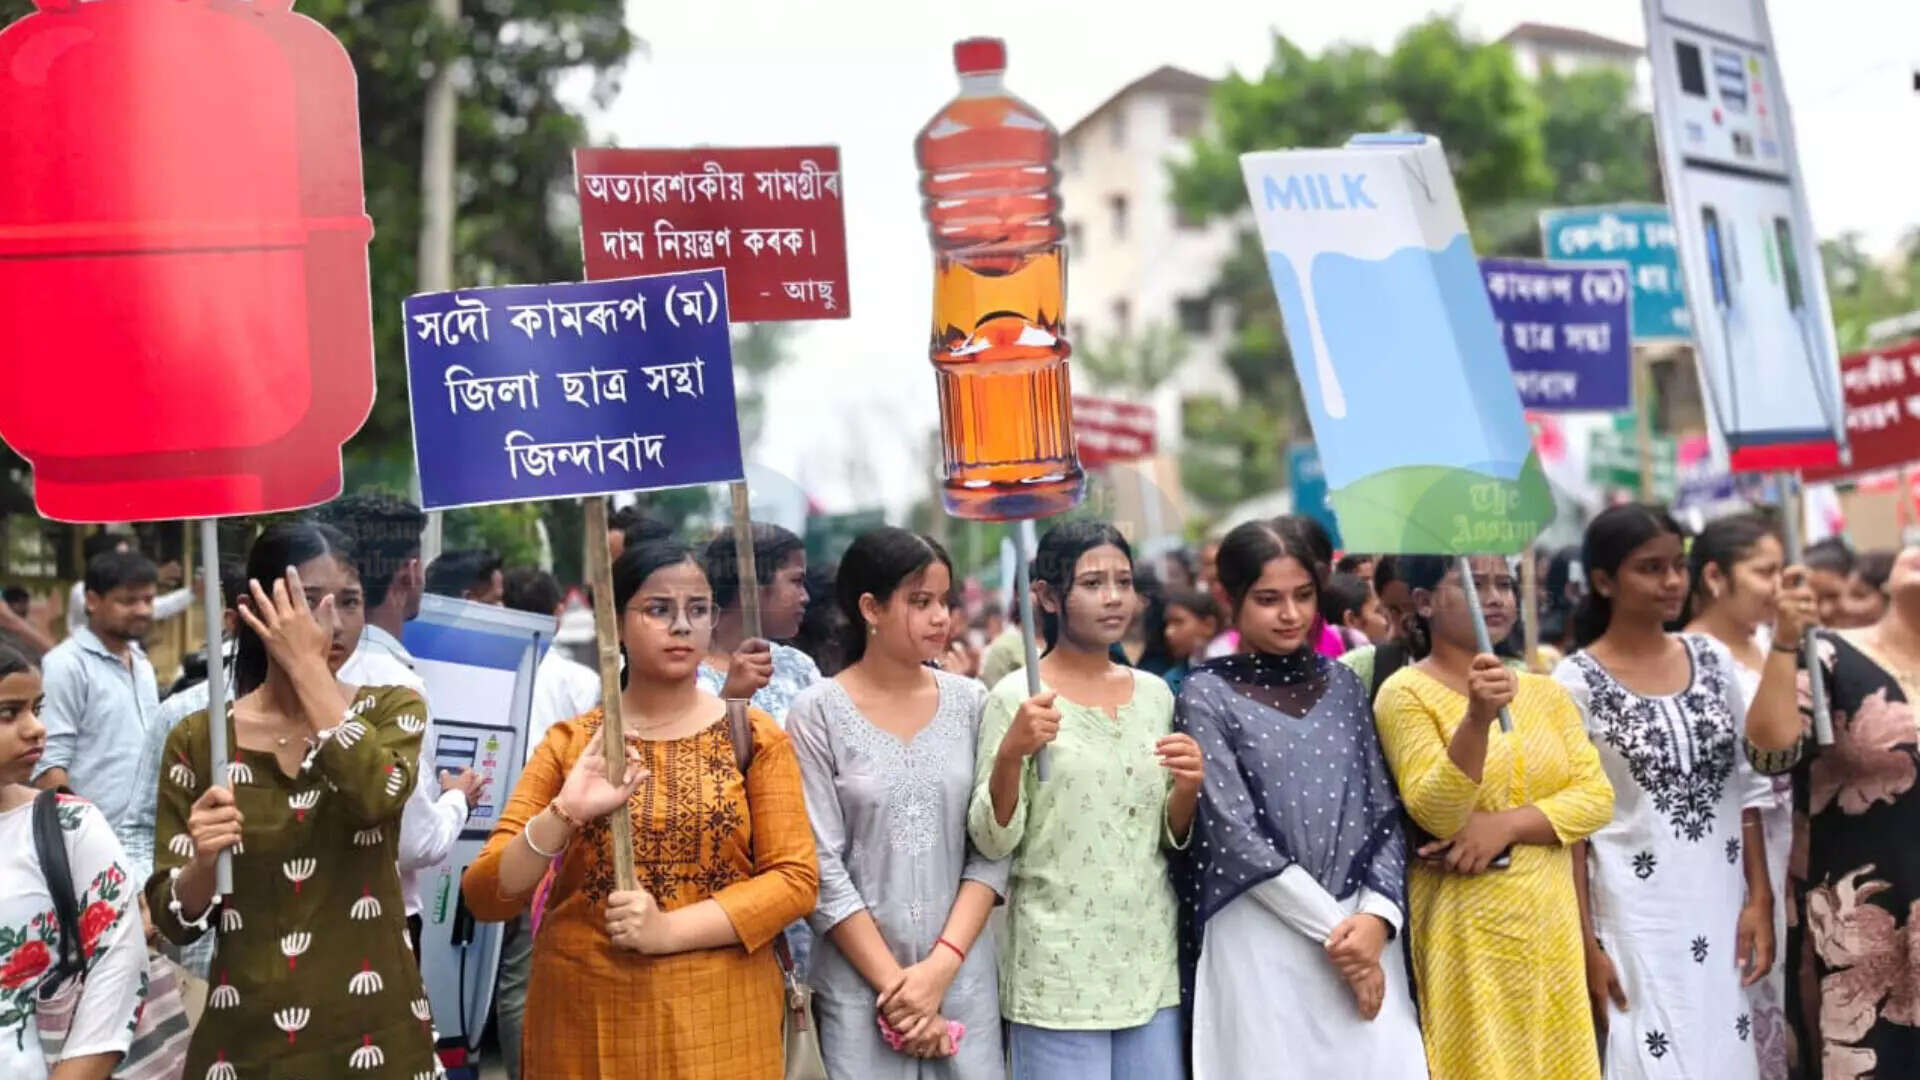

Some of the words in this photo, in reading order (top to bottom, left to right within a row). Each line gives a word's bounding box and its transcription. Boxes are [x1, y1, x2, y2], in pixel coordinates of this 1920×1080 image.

[1262, 173, 1378, 211] MILK
[600, 228, 645, 260] দাম
[411, 294, 493, 347] সদৌ
[506, 292, 647, 341] কামৰূপ
[664, 280, 719, 328] (ম)
[782, 279, 837, 310] আছু
[444, 364, 541, 415] জিলা
[504, 430, 666, 480] জিন্দাবাদ
